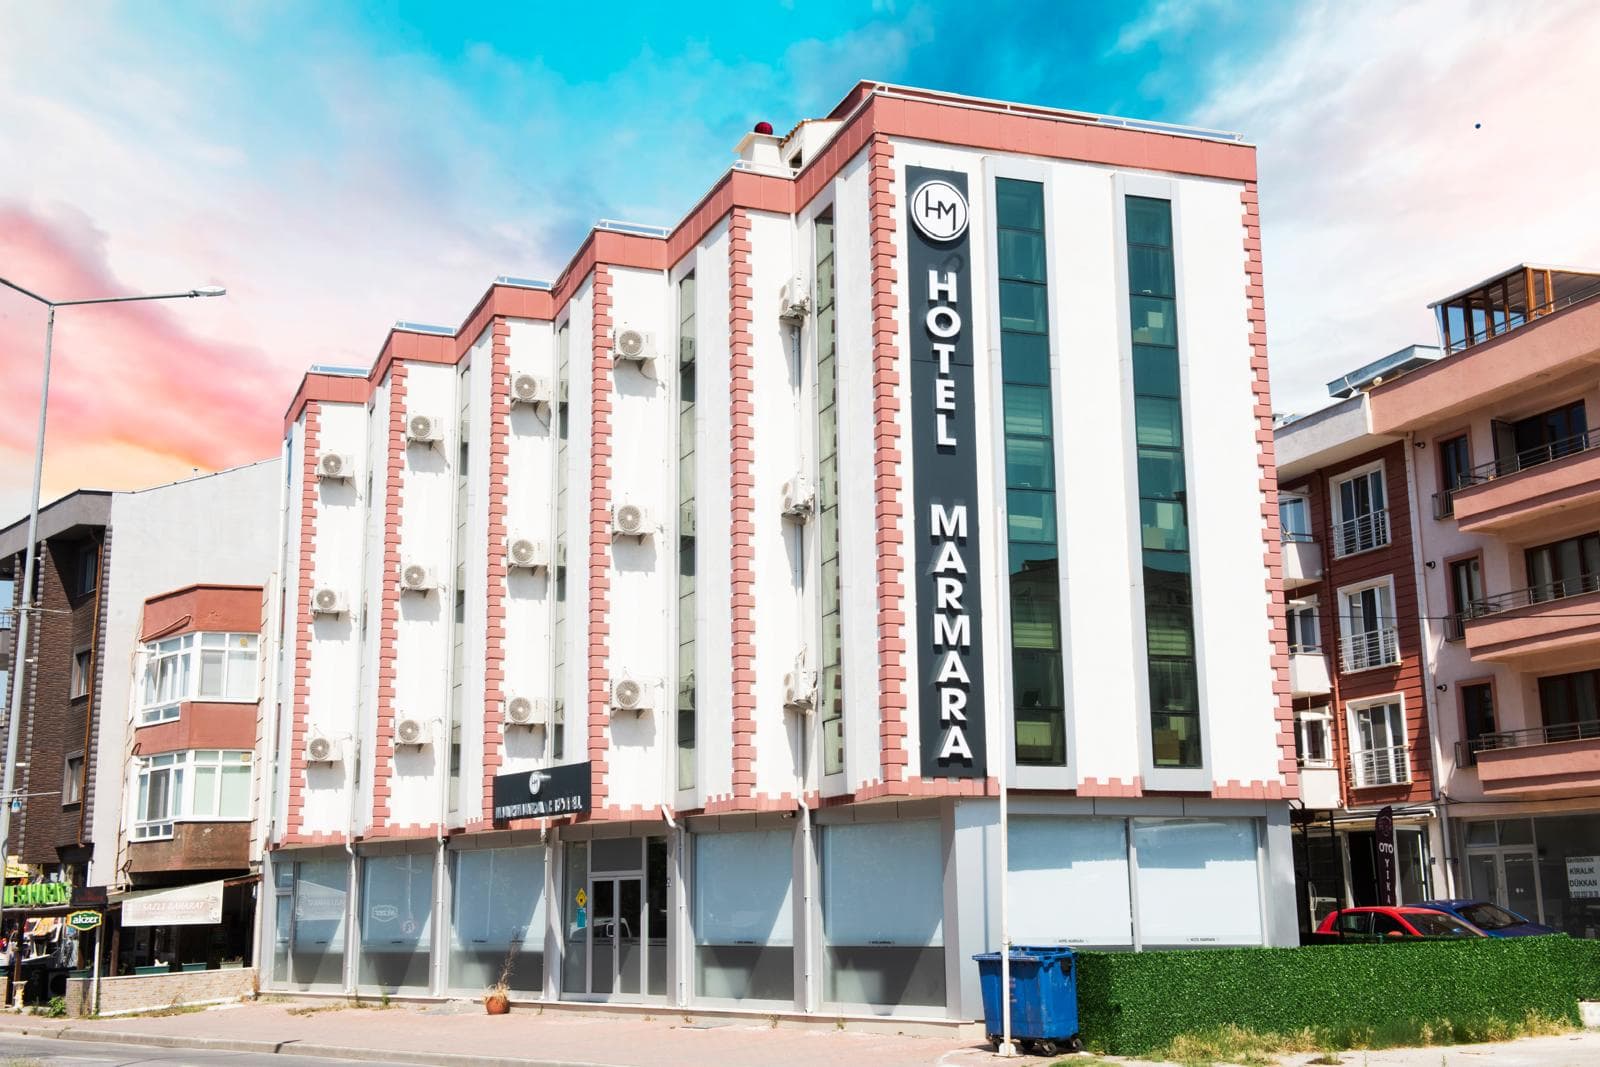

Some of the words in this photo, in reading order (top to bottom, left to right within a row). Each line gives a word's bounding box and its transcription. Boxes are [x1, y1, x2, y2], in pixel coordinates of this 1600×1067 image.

[925, 190, 957, 231] HM
[926, 269, 962, 447] HOTEL
[930, 503, 974, 759] MARMARA
[1379, 842, 1394, 854] OTO
